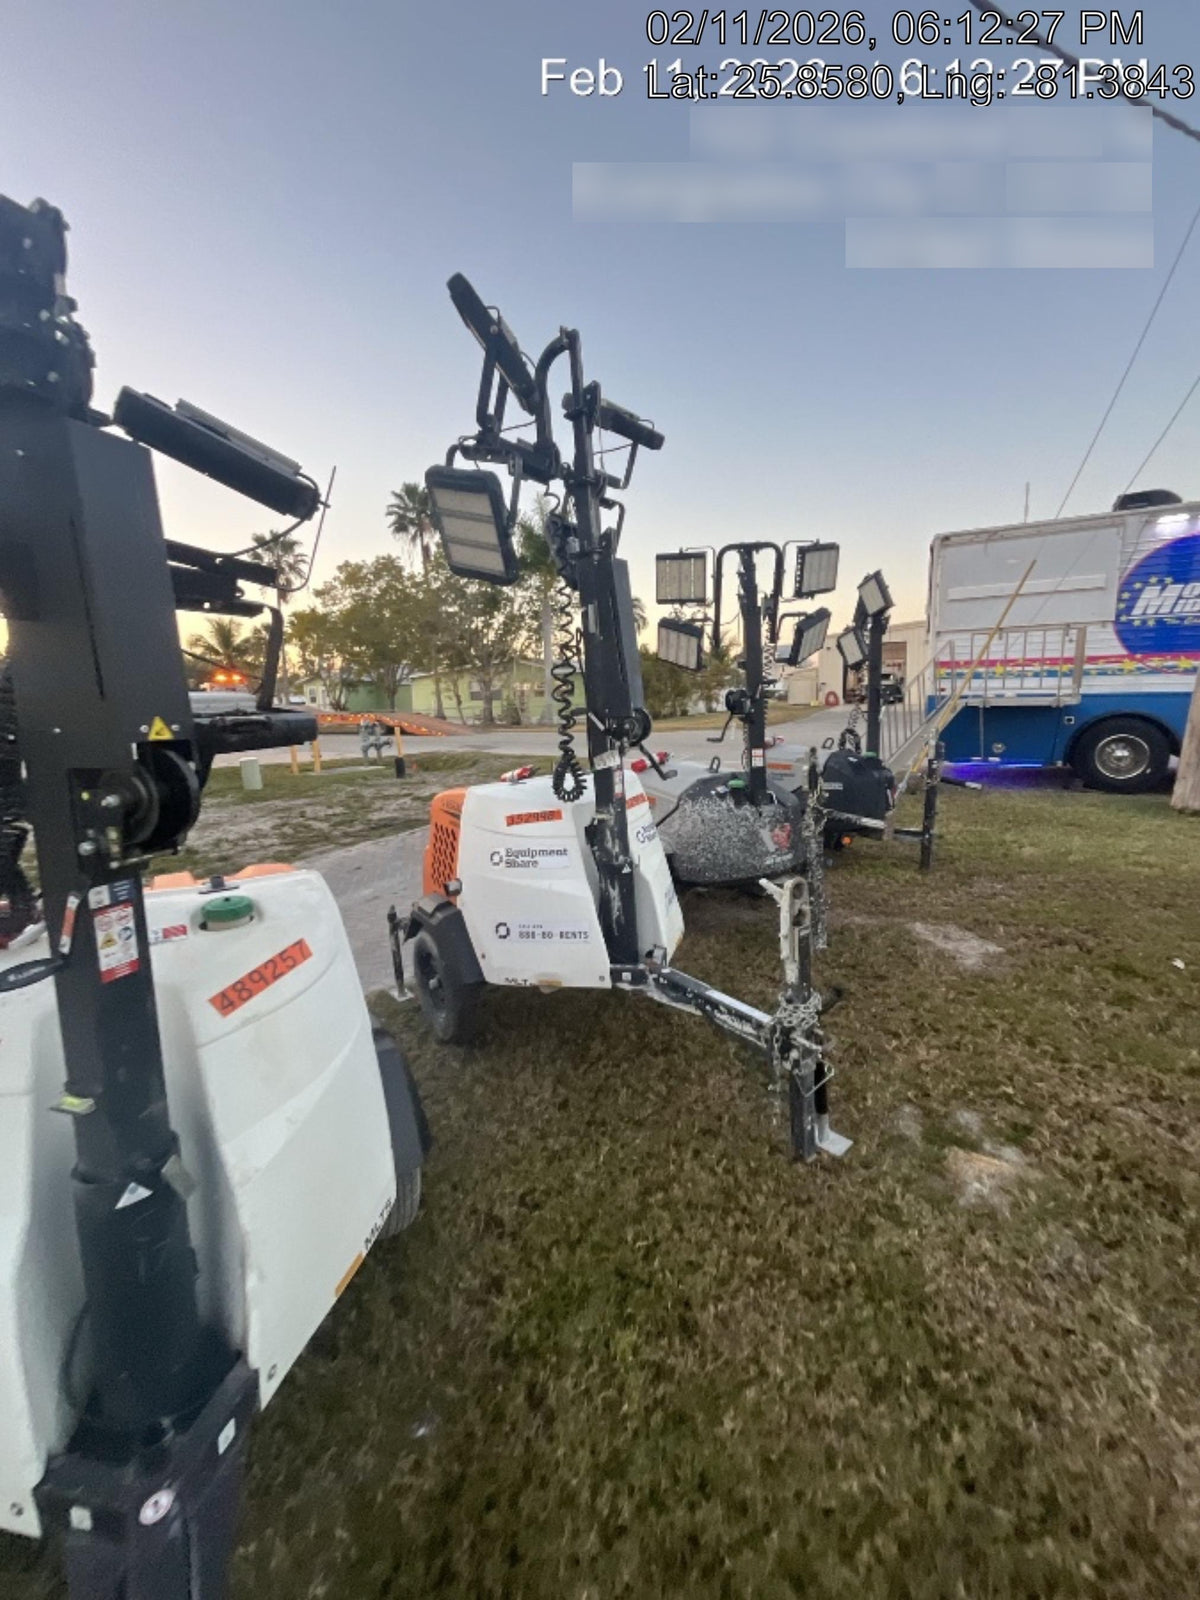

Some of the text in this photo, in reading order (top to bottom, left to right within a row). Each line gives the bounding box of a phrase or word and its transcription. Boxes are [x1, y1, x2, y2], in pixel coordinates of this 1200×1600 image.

[505, 847, 568, 859] Equipment
[505, 859, 539, 868] Share
[221, 938, 307, 1010] 489257
